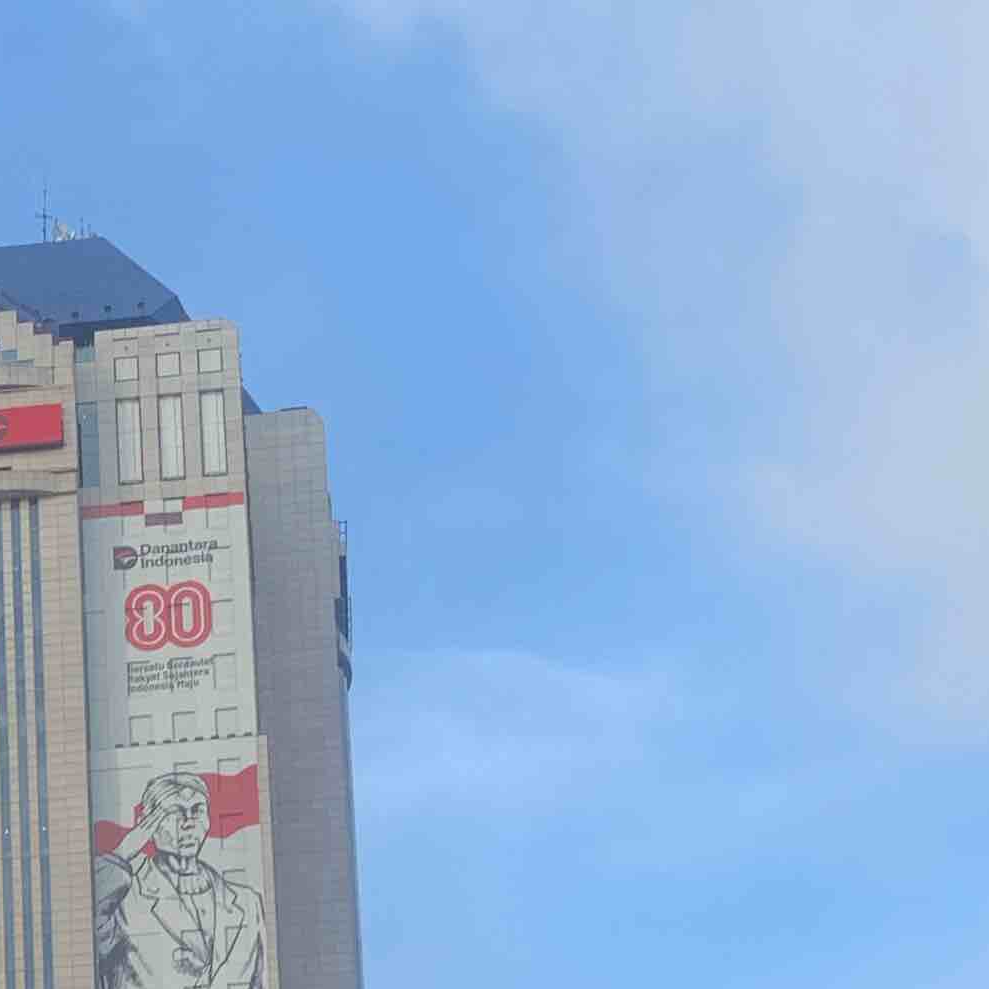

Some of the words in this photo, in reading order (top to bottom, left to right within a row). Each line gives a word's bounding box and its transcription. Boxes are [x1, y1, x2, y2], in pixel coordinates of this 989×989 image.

[140, 540, 218, 556] Danantara
[140, 551, 213, 568] Indonesia
[124, 580, 212, 651] 80
